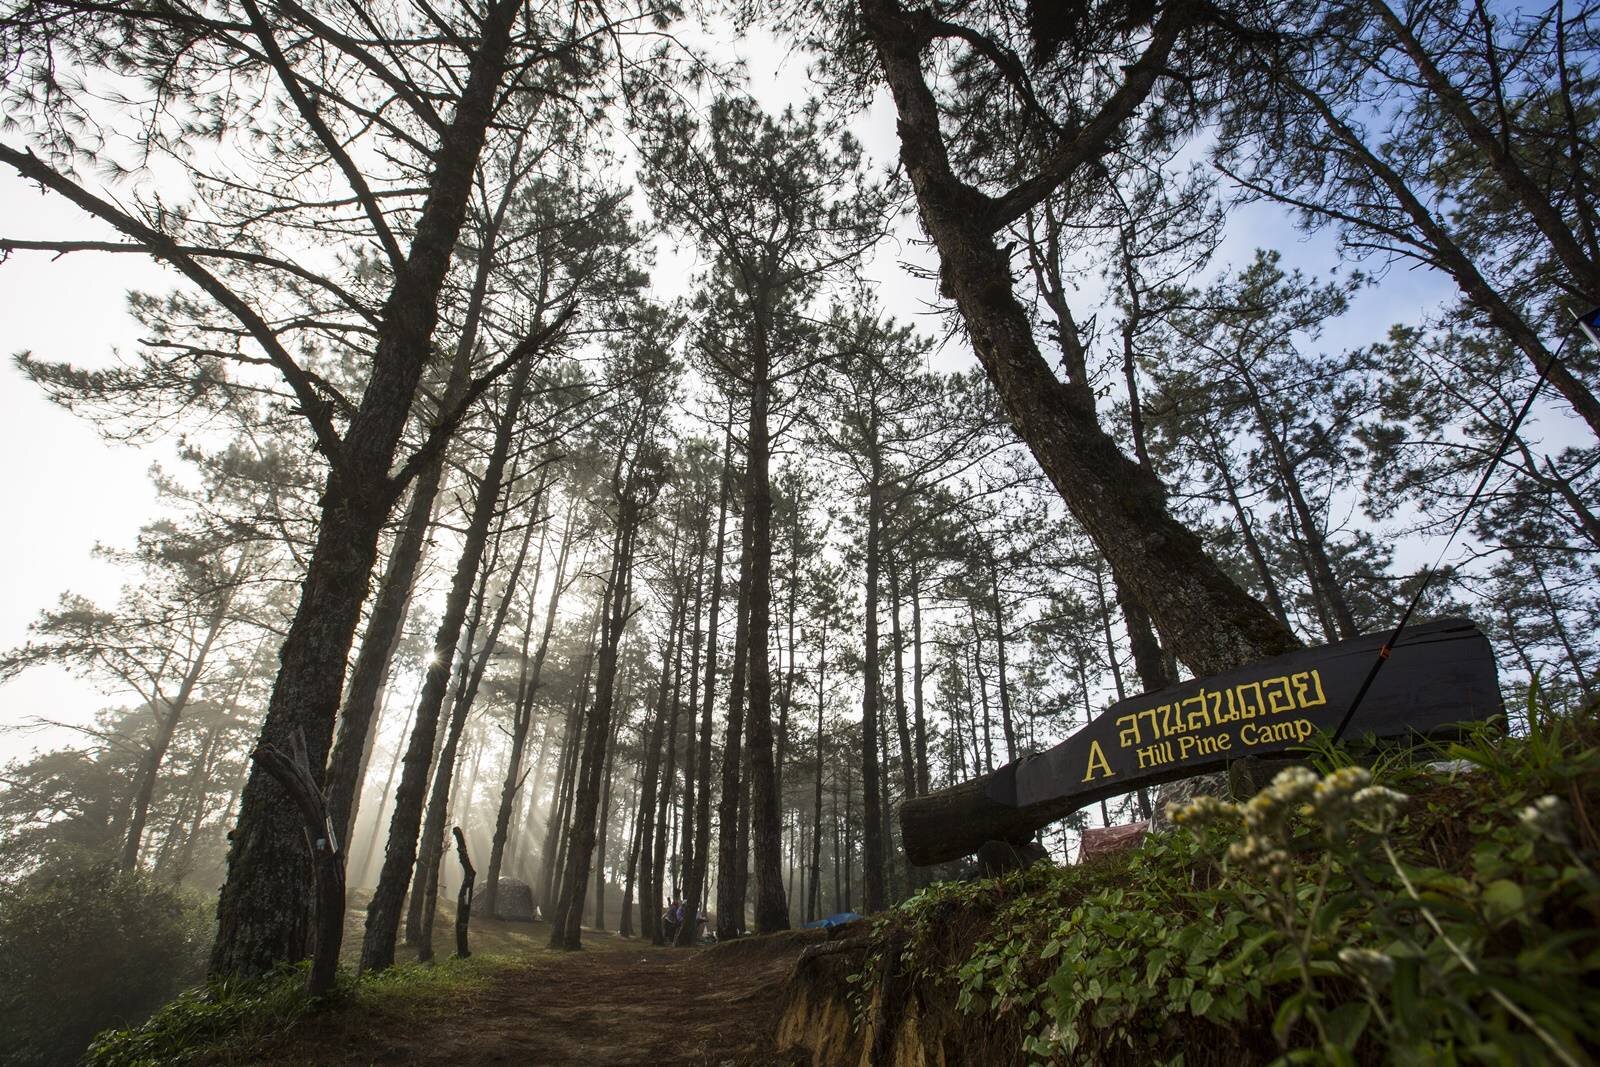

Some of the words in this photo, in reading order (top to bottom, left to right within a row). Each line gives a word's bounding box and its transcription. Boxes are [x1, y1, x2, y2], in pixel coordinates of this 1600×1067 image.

[1116, 670, 1327, 748] ลานสนดอย
[1081, 740, 1116, 783] A
[1136, 741, 1175, 769] Hill
[1177, 731, 1232, 759] Pine
[1239, 718, 1313, 746] Camp
